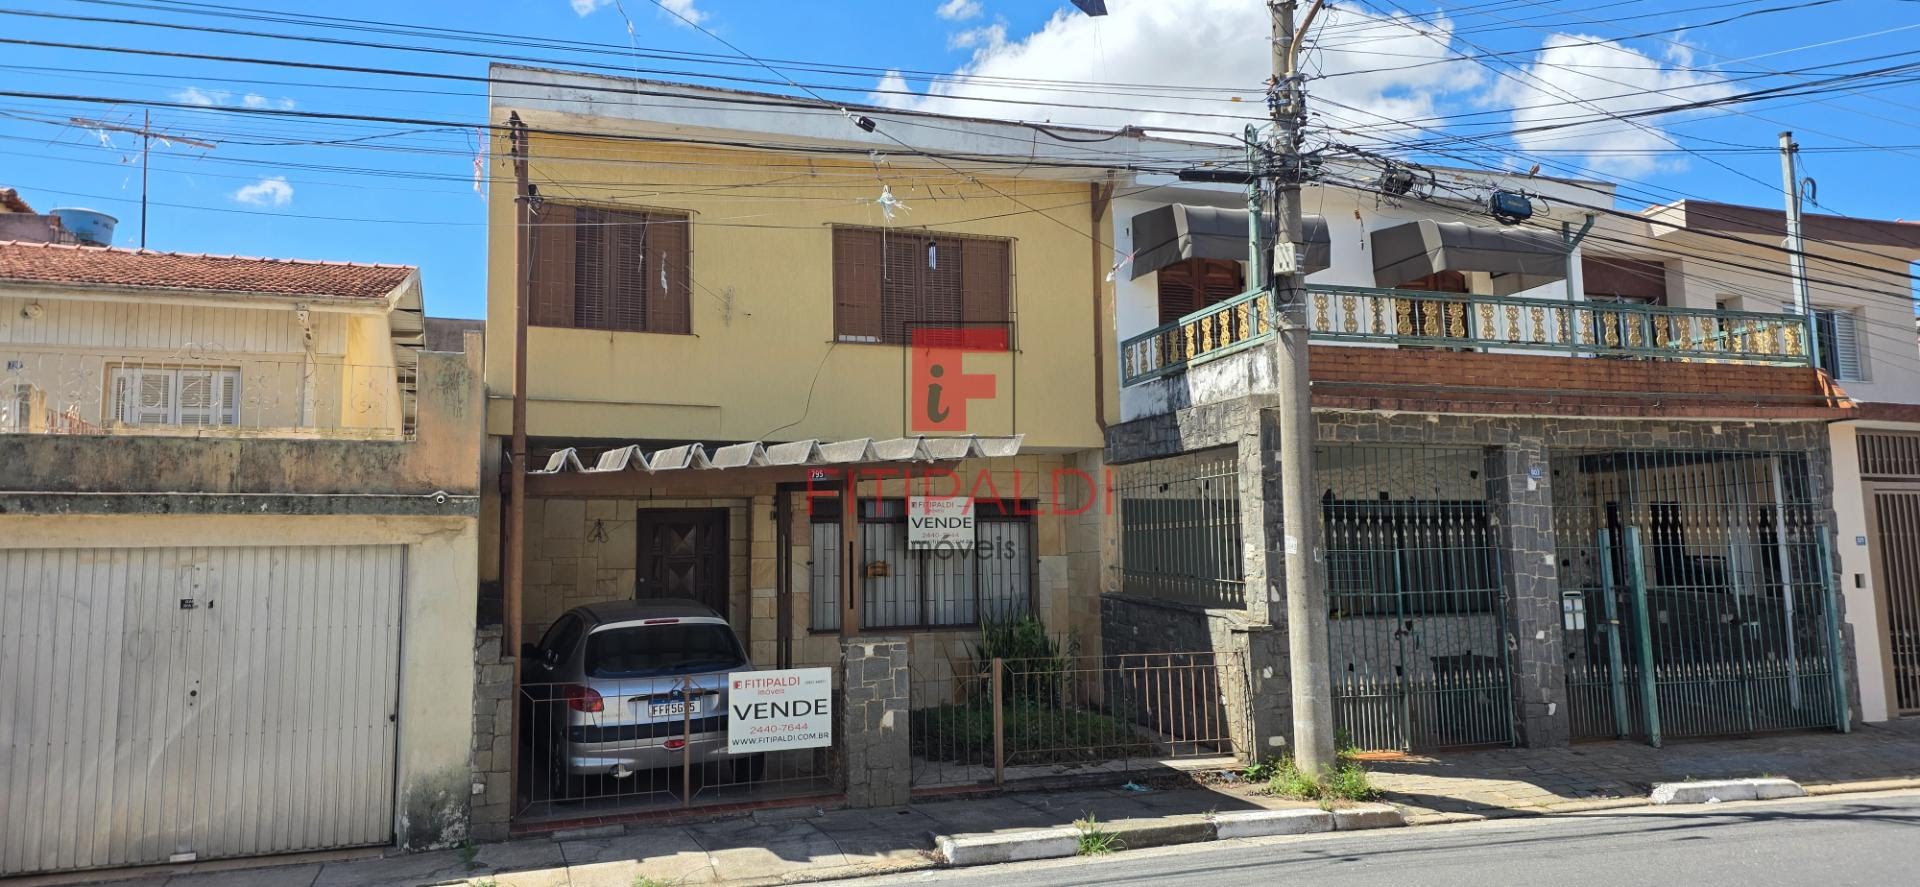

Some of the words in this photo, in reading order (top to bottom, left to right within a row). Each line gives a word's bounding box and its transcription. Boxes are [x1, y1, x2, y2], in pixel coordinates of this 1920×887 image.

[811, 470, 824, 478] 795
[911, 516, 972, 529] VENDE
[744, 676, 800, 689] FITIPALDI
[652, 702, 696, 716] FFF5G5
[733, 698, 828, 721] VENDE
[750, 722, 809, 735] 2440-7644
[732, 731, 829, 746] WWW.FITIPALDI.COM.BR
